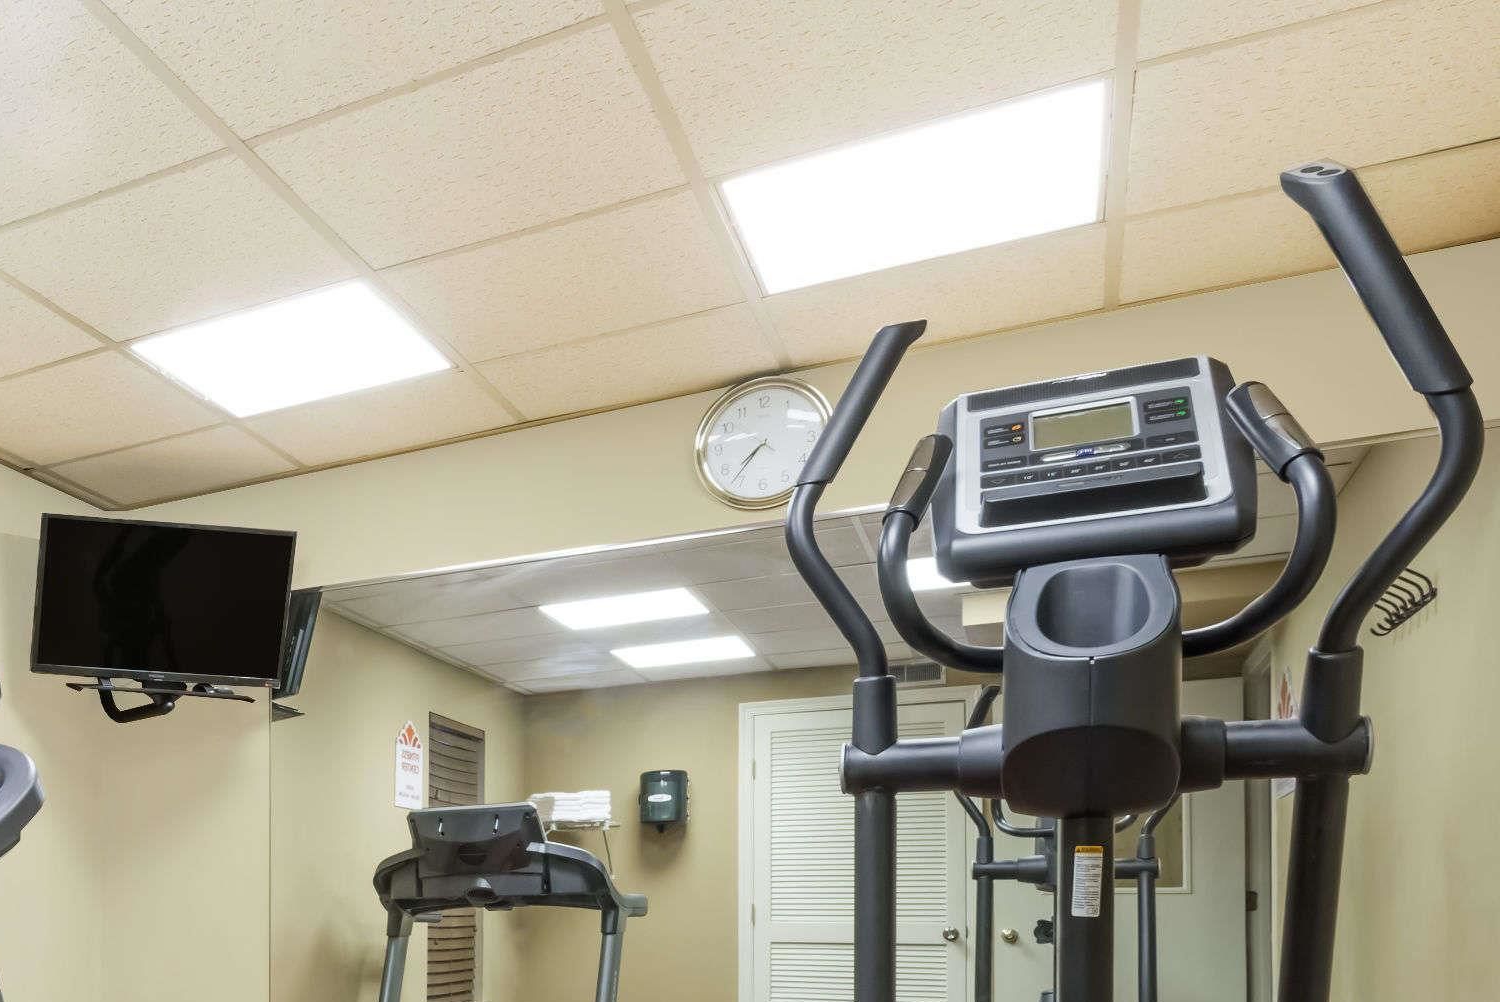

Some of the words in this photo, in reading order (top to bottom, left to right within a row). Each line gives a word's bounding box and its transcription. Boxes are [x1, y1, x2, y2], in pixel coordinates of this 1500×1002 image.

[759, 396, 771, 409] 12
[737, 407, 747, 418] 11
[722, 421, 735, 432] 10
[713, 443, 724, 456] 9
[720, 463, 731, 475] 8
[758, 478, 768, 491] 6
